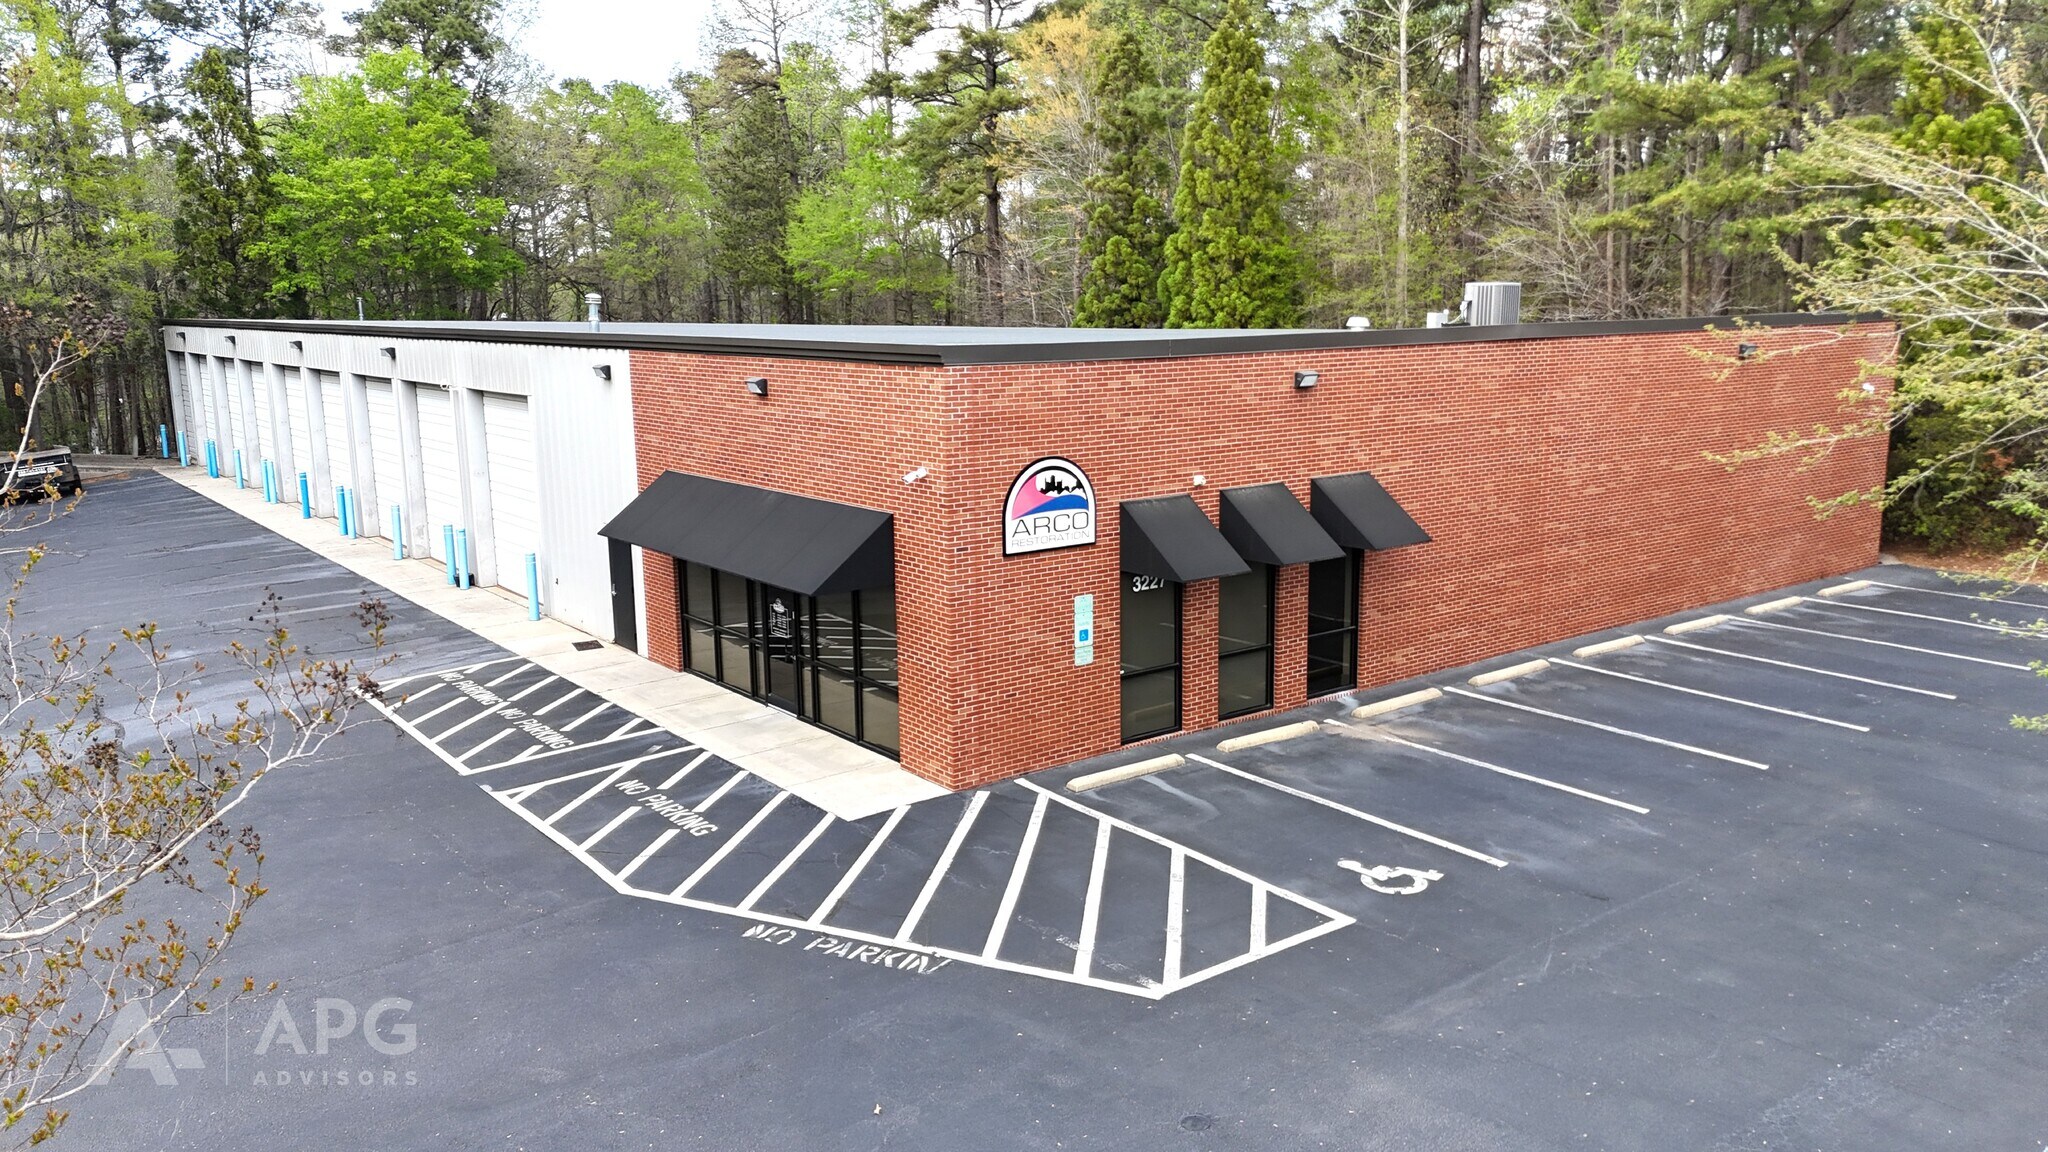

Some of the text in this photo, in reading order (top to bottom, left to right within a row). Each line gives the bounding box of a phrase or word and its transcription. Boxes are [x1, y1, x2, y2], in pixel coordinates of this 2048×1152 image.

[1011, 530, 1090, 548] RESTORATION
[1012, 511, 1089, 538] ARCO
[437, 671, 504, 706] NO PARKING
[496, 708, 574, 749] NO PARKING
[614, 779, 718, 836] NO PARKING
[741, 923, 797, 945] NO
